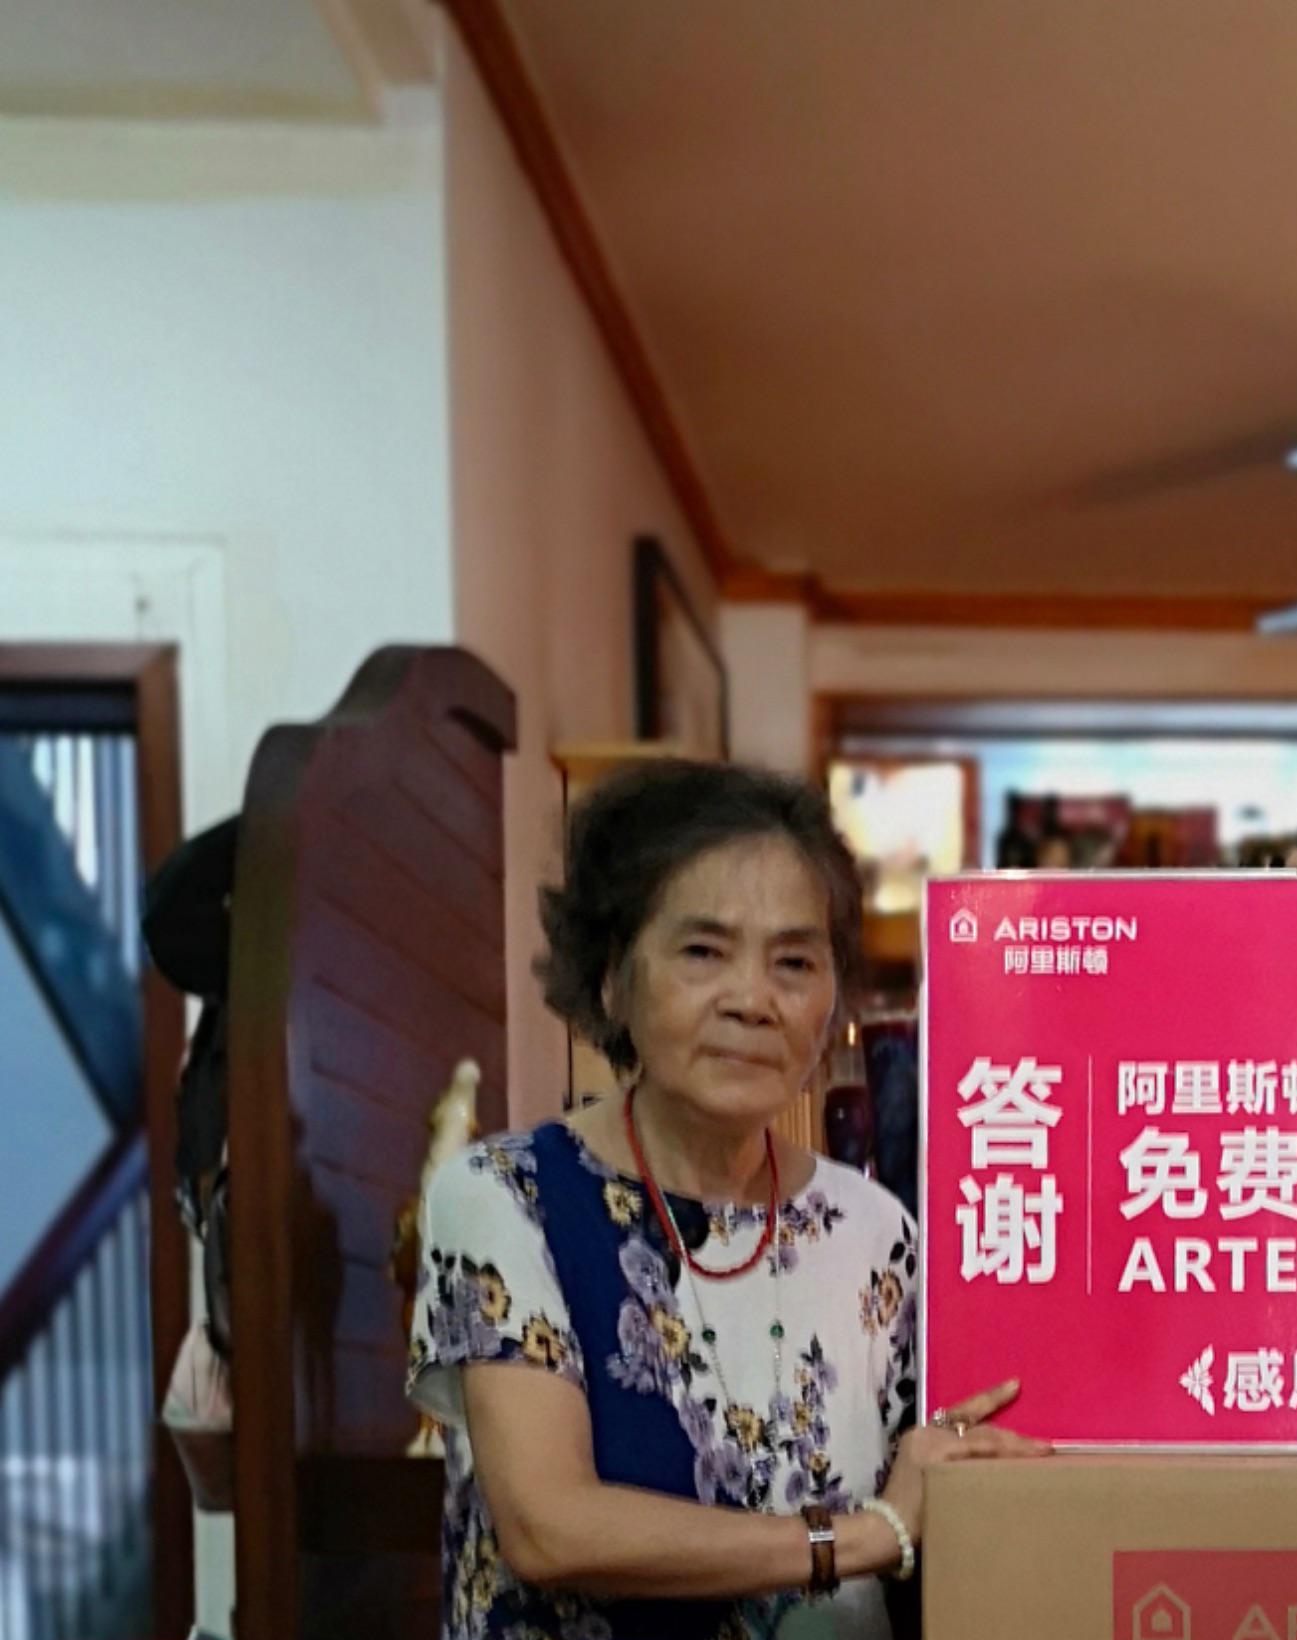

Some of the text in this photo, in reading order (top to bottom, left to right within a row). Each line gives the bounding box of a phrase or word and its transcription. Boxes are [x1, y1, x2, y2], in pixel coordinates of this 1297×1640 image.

[993, 916, 1138, 941] ARISTON
[1004, 945, 1109, 975] 阿里斯顿
[956, 1056, 1063, 1287] 答谢
